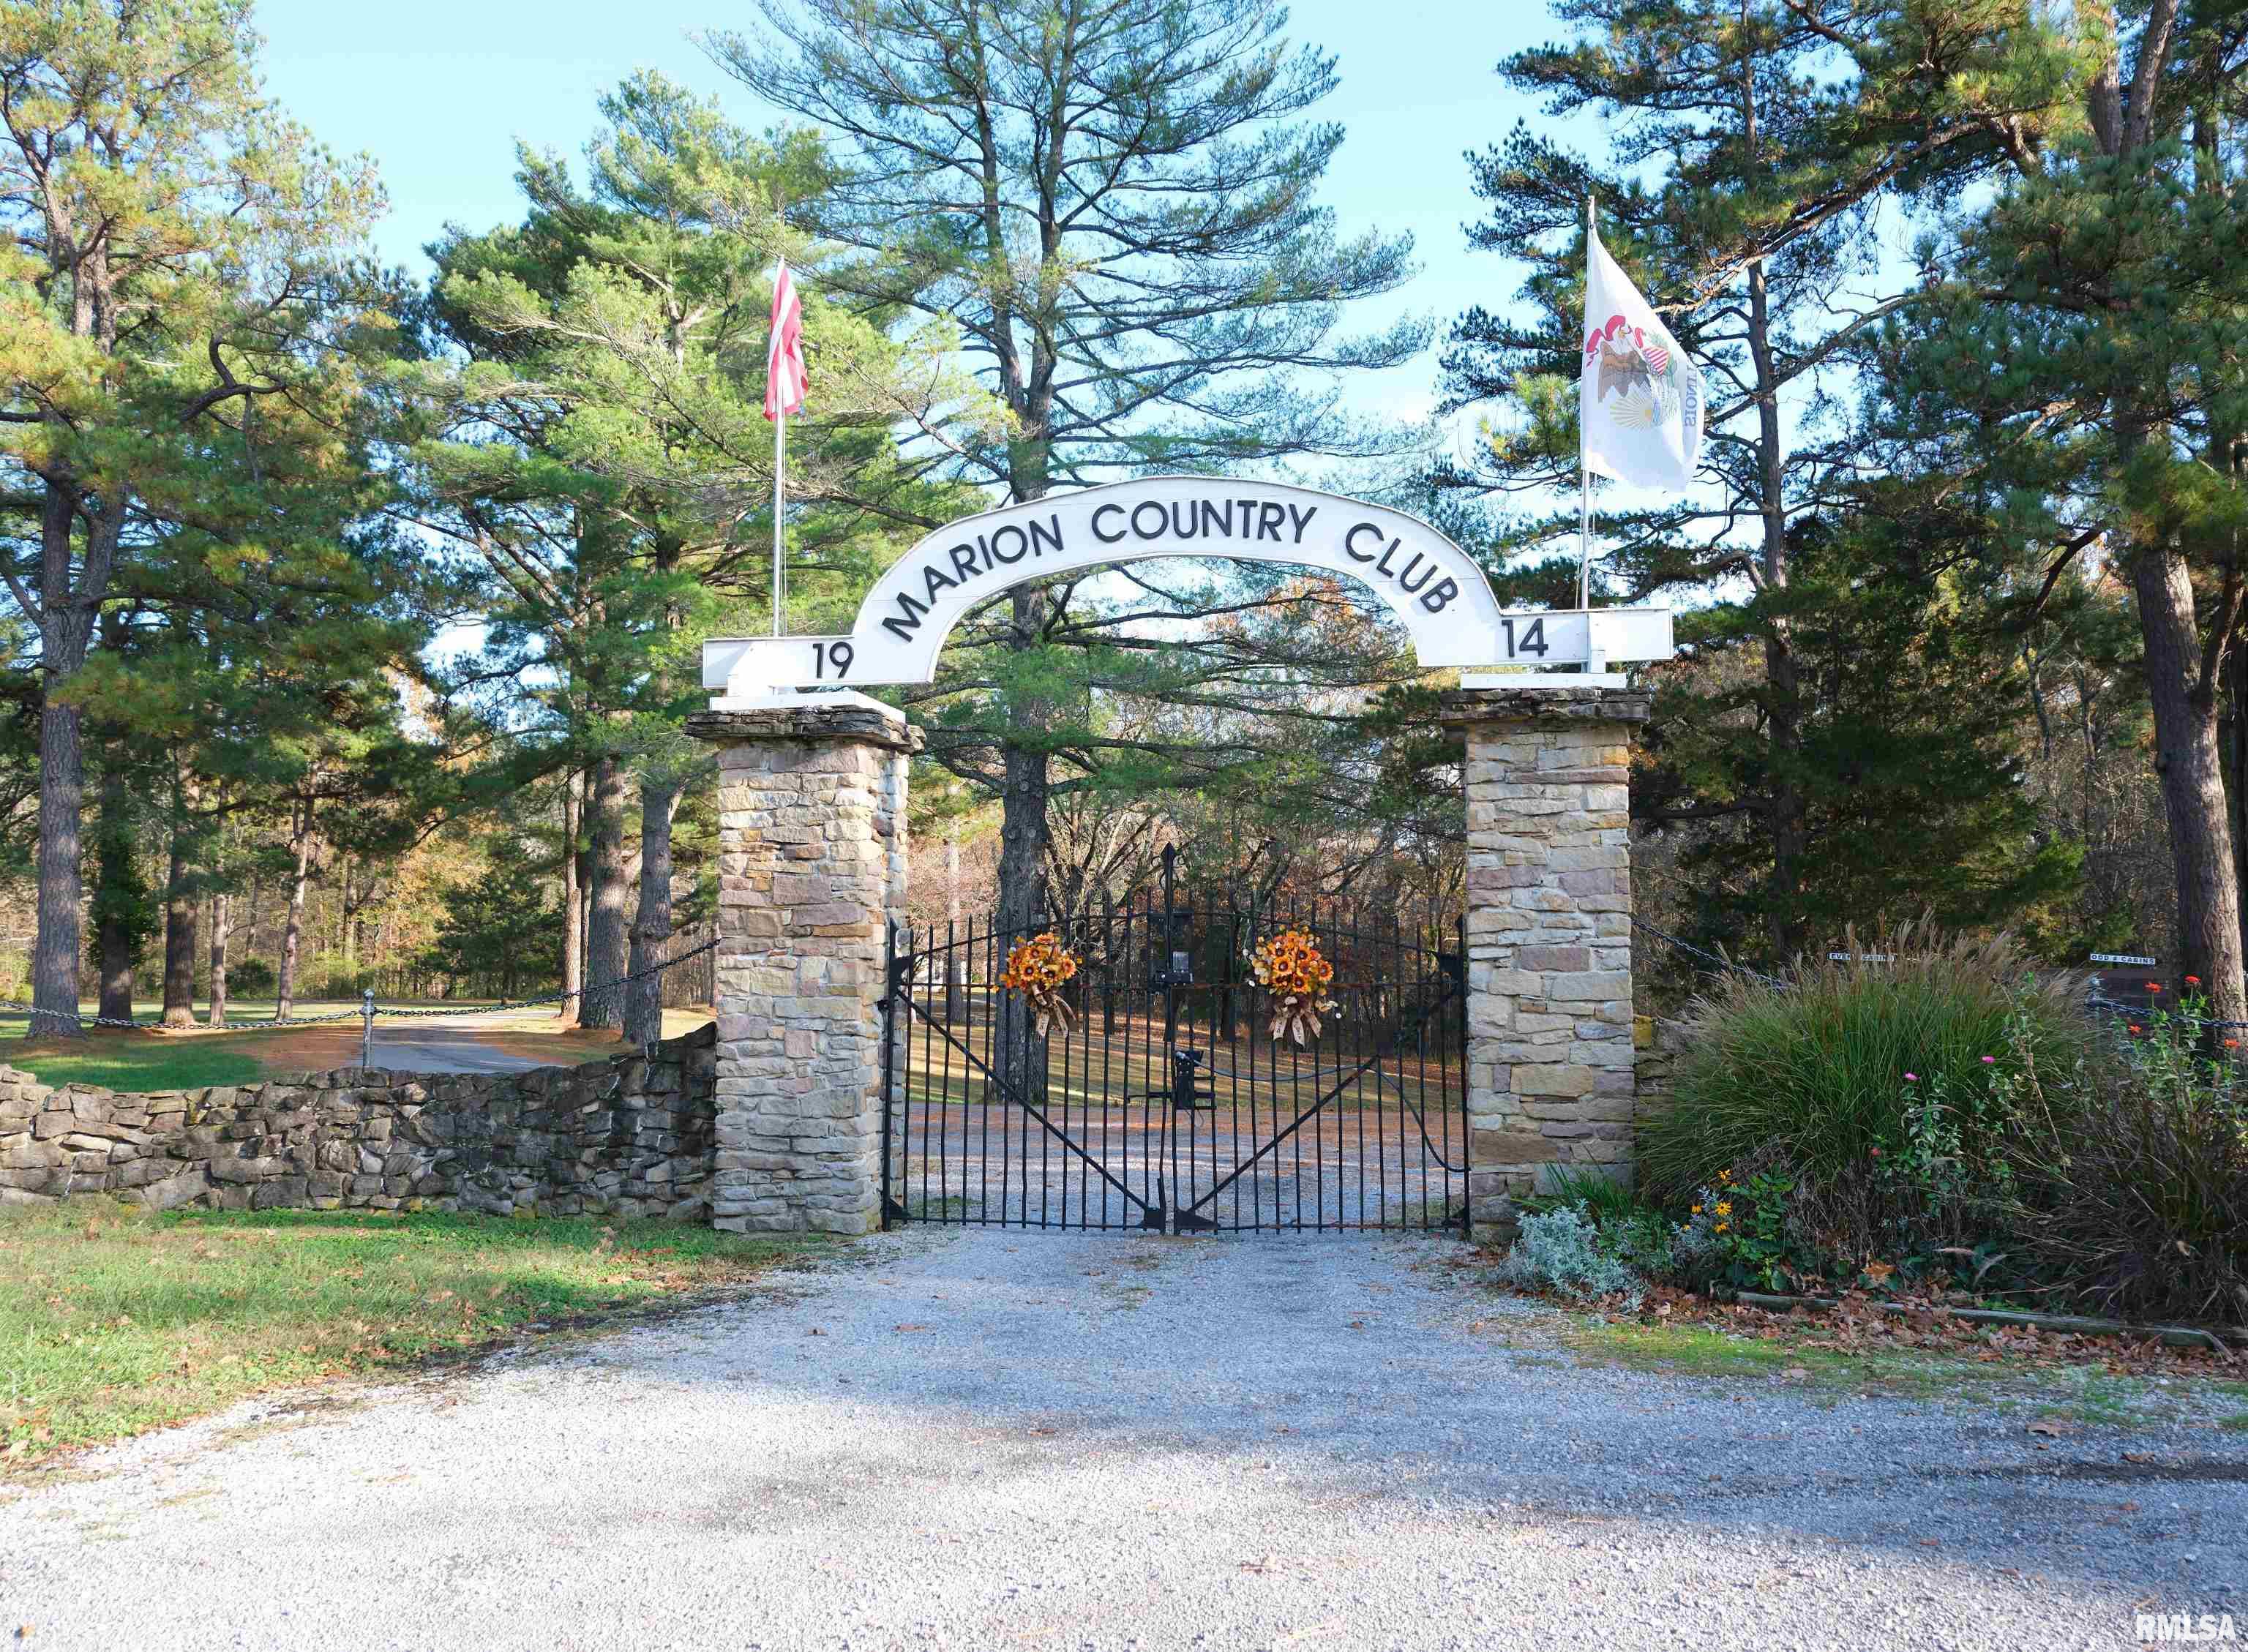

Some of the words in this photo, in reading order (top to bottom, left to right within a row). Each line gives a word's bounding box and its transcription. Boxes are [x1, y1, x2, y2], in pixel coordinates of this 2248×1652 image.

[882, 514, 1064, 642] MARION
[1091, 500, 1318, 544] COUNTRY
[1345, 523, 1458, 613] CLUB
[1501, 617, 1549, 658] 14
[812, 641, 855, 679] 19
[2121, 956, 2154, 964] CABINS
